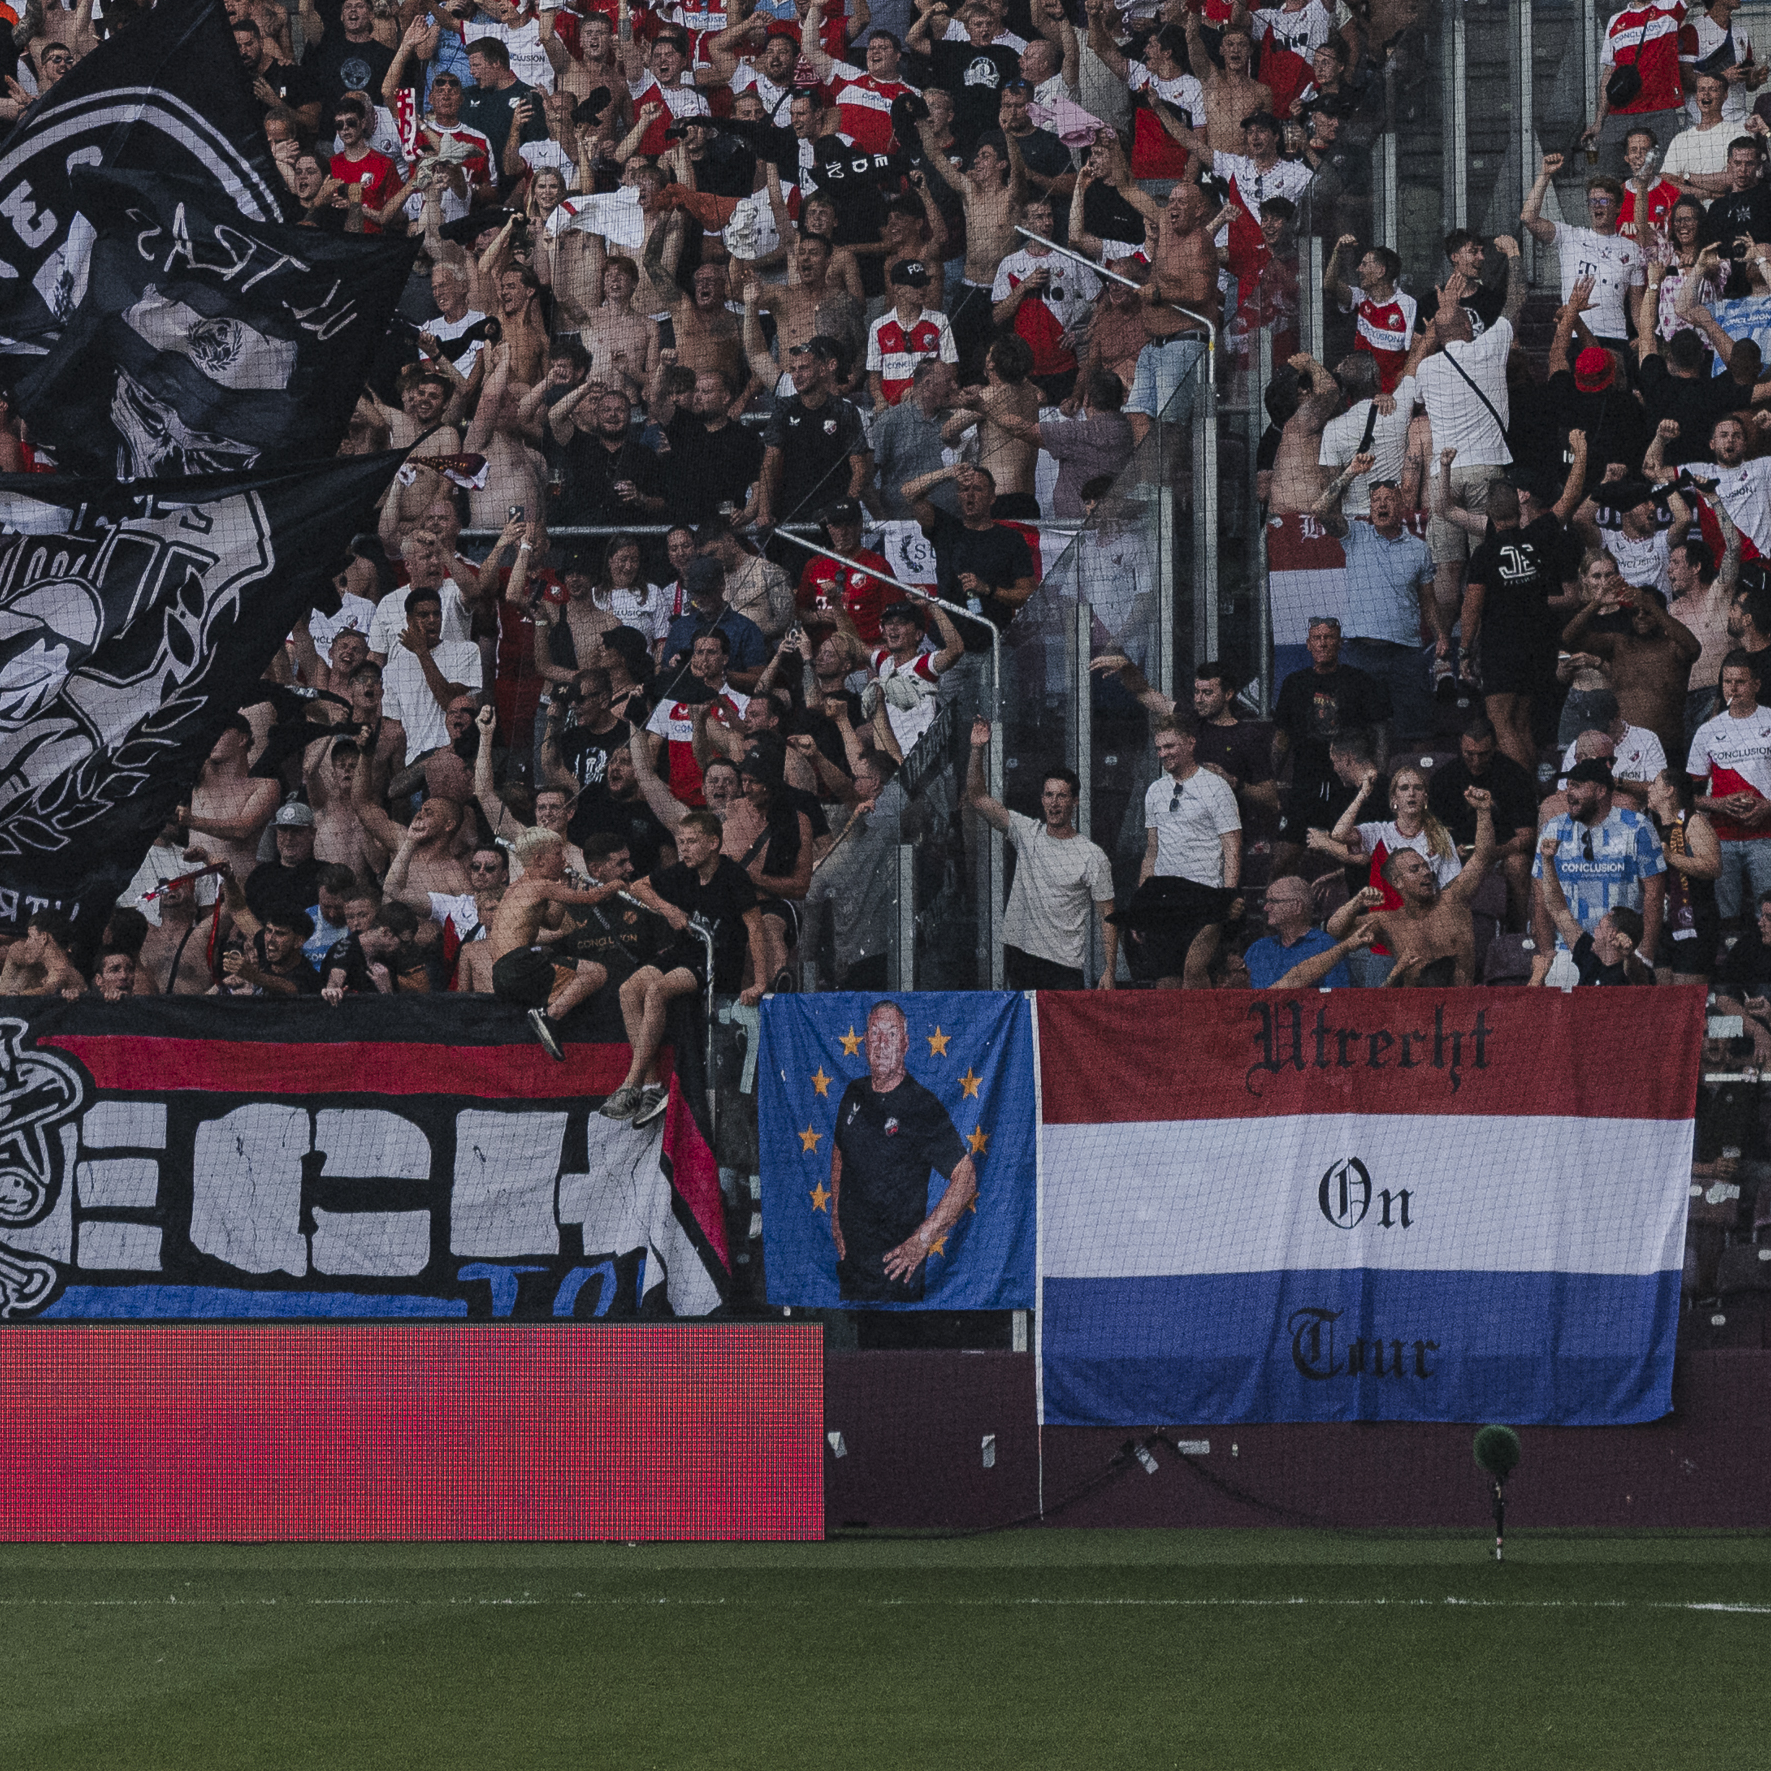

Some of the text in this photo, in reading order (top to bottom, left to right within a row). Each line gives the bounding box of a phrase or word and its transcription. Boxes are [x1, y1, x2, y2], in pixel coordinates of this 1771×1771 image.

[1561, 862, 1626, 875] CONCLUSION
[1246, 998, 1493, 1100] Utrecht
[1317, 1156, 1415, 1230] On
[1287, 1305, 1441, 1381] Tour
